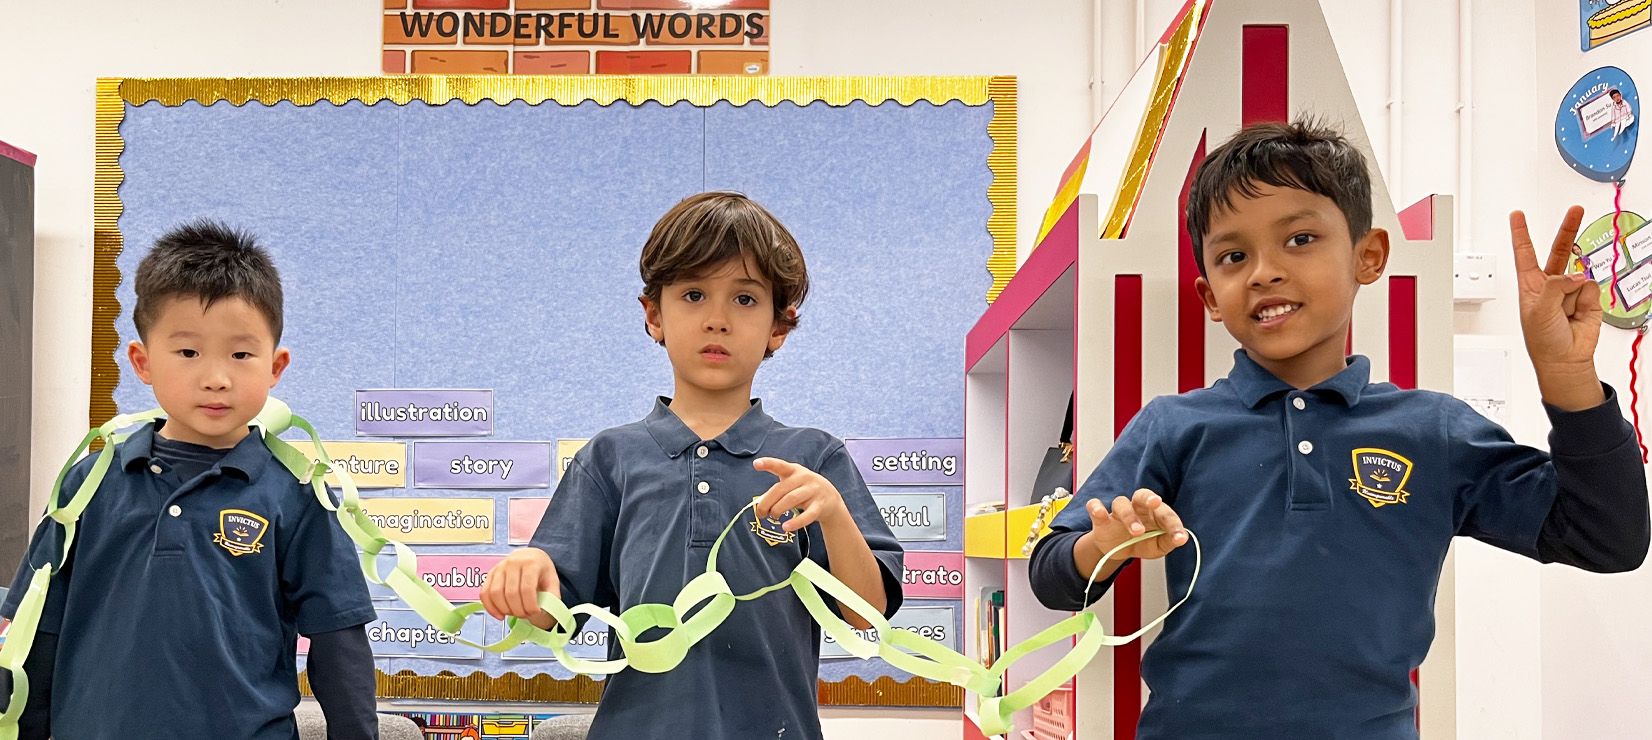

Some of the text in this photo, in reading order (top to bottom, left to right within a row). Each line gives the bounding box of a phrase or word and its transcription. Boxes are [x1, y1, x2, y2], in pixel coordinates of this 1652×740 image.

[400, 12, 764, 39] WONDERFUL WORDS
[1569, 81, 1609, 115] January
[1590, 229, 1614, 250] June
[360, 402, 487, 421] illustration
[450, 455, 513, 480] story
[872, 450, 956, 476] setting
[1362, 456, 1402, 472] INVICTUS
[227, 515, 261, 529] INVICTUS
